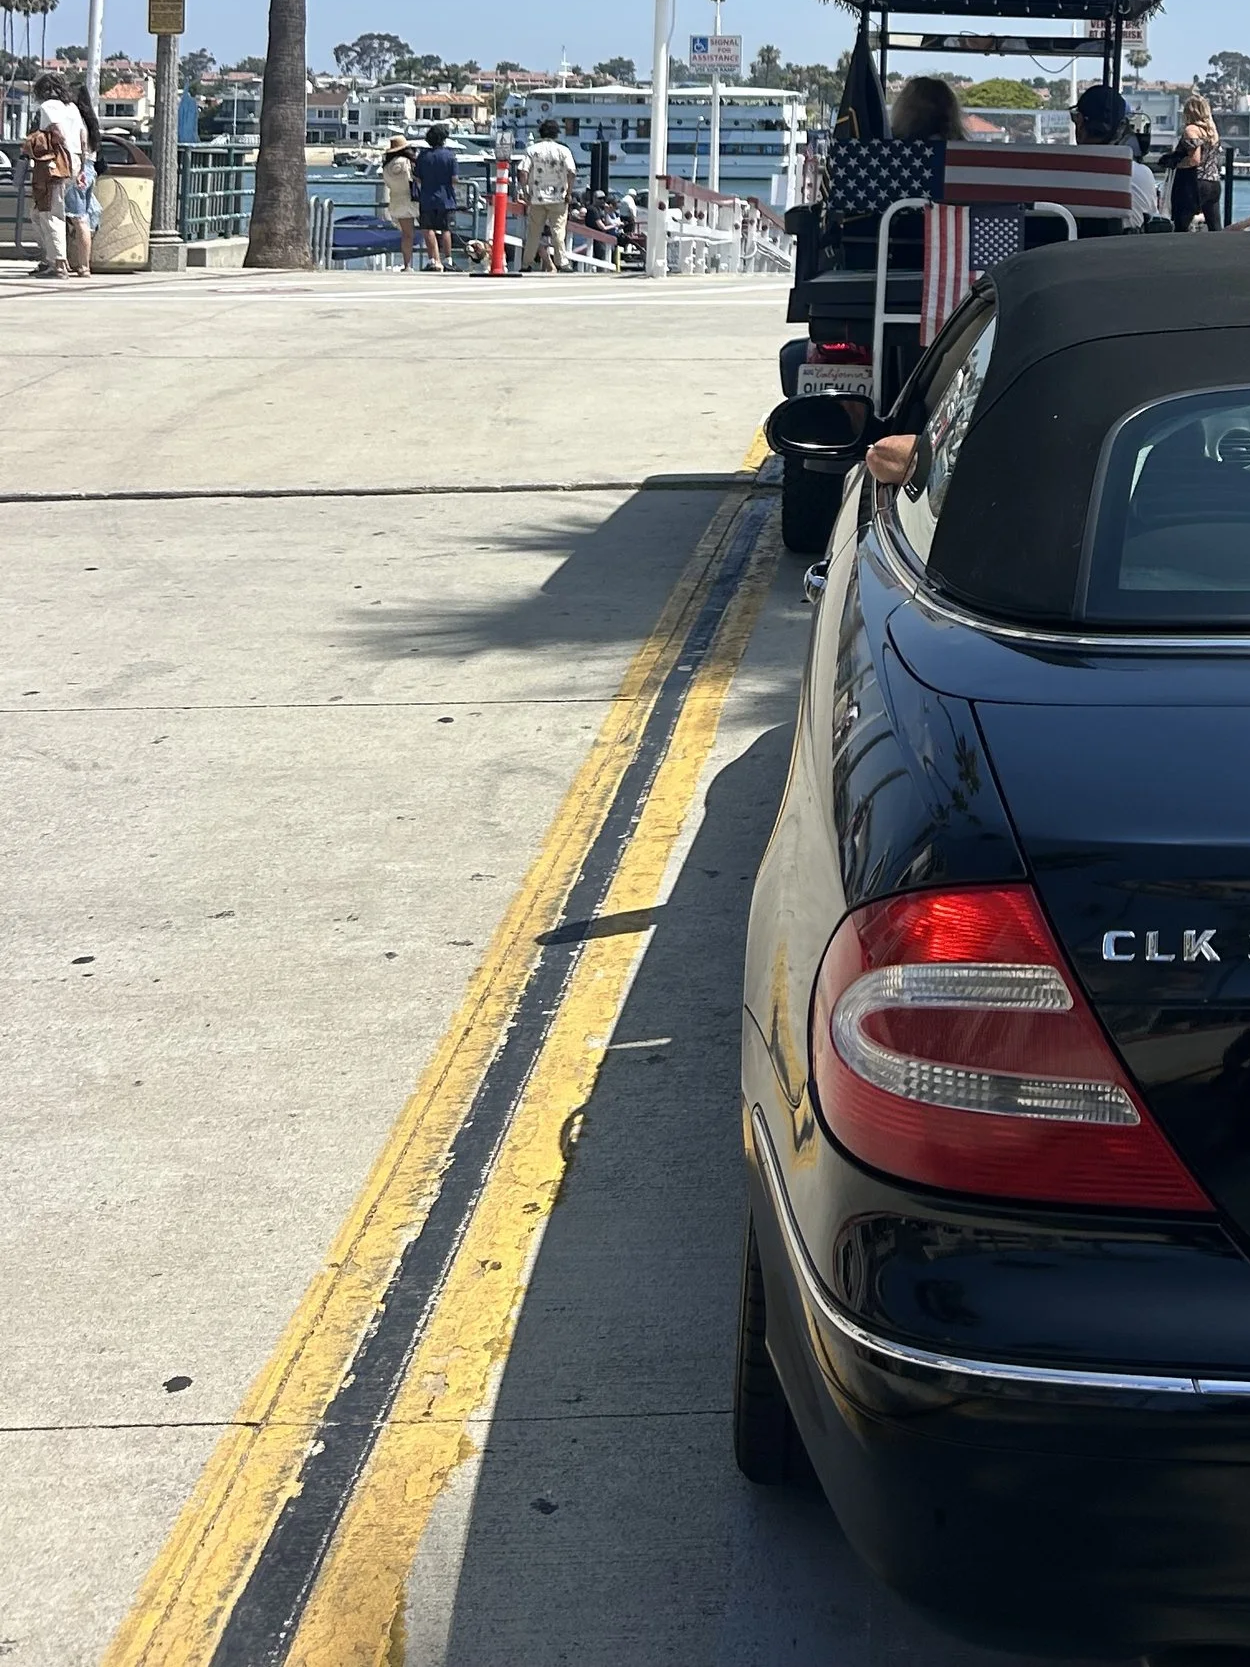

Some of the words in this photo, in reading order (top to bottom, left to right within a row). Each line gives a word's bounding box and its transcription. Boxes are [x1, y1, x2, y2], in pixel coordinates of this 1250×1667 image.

[710, 38, 740, 47] SIGNAL
[692, 54, 740, 62] ASSISTANCE
[1102, 929, 1221, 962] CLK
